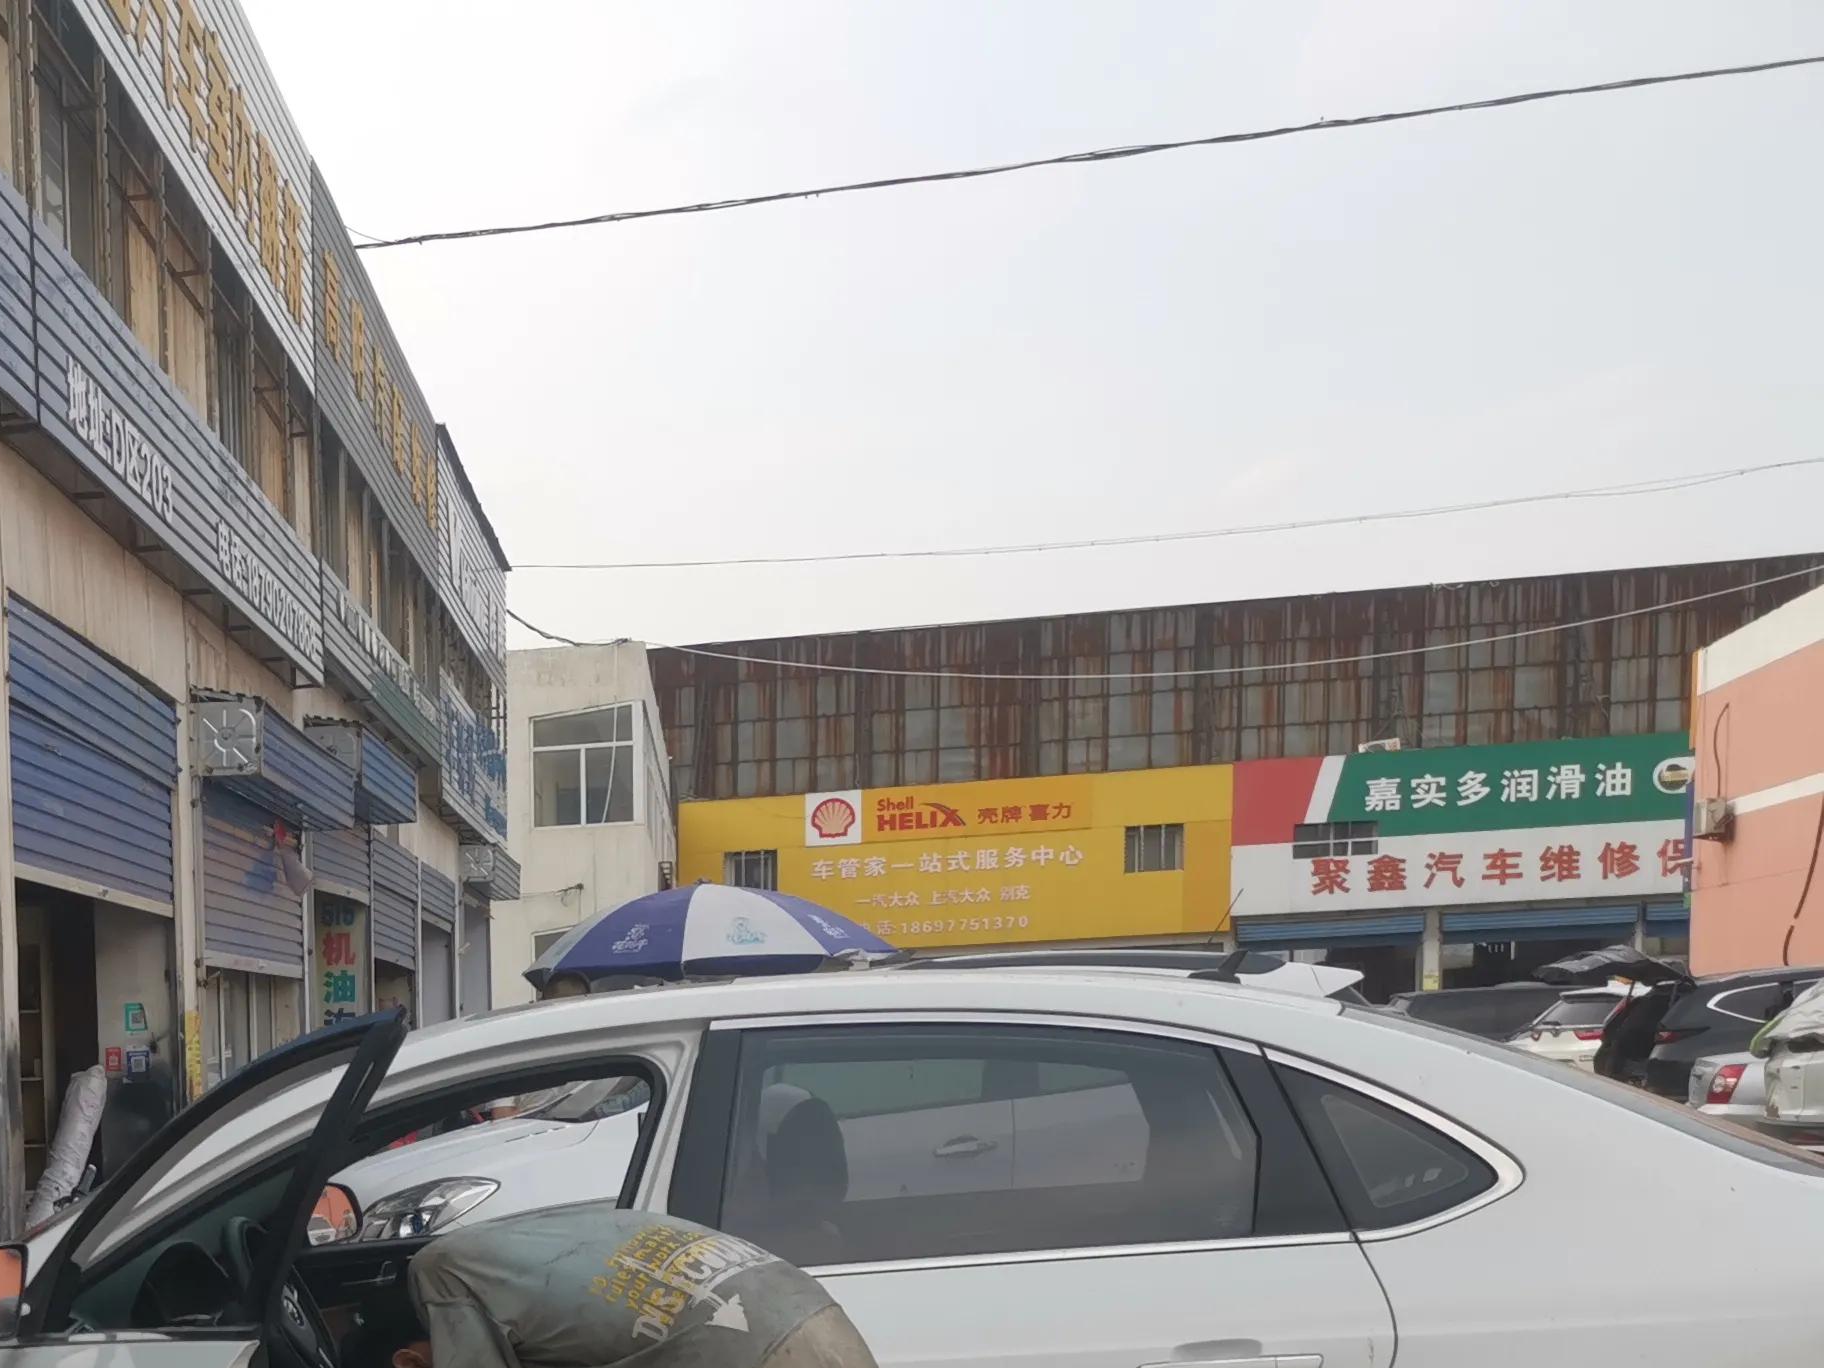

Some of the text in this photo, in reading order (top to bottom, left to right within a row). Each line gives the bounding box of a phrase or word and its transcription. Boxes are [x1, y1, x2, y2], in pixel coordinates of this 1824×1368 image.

[1364, 761, 1633, 813] 嘉实多润滑油
[877, 796, 914, 812] Shell
[877, 807, 966, 832] HELIX
[810, 844, 1084, 880] 车管家一站式服务中心
